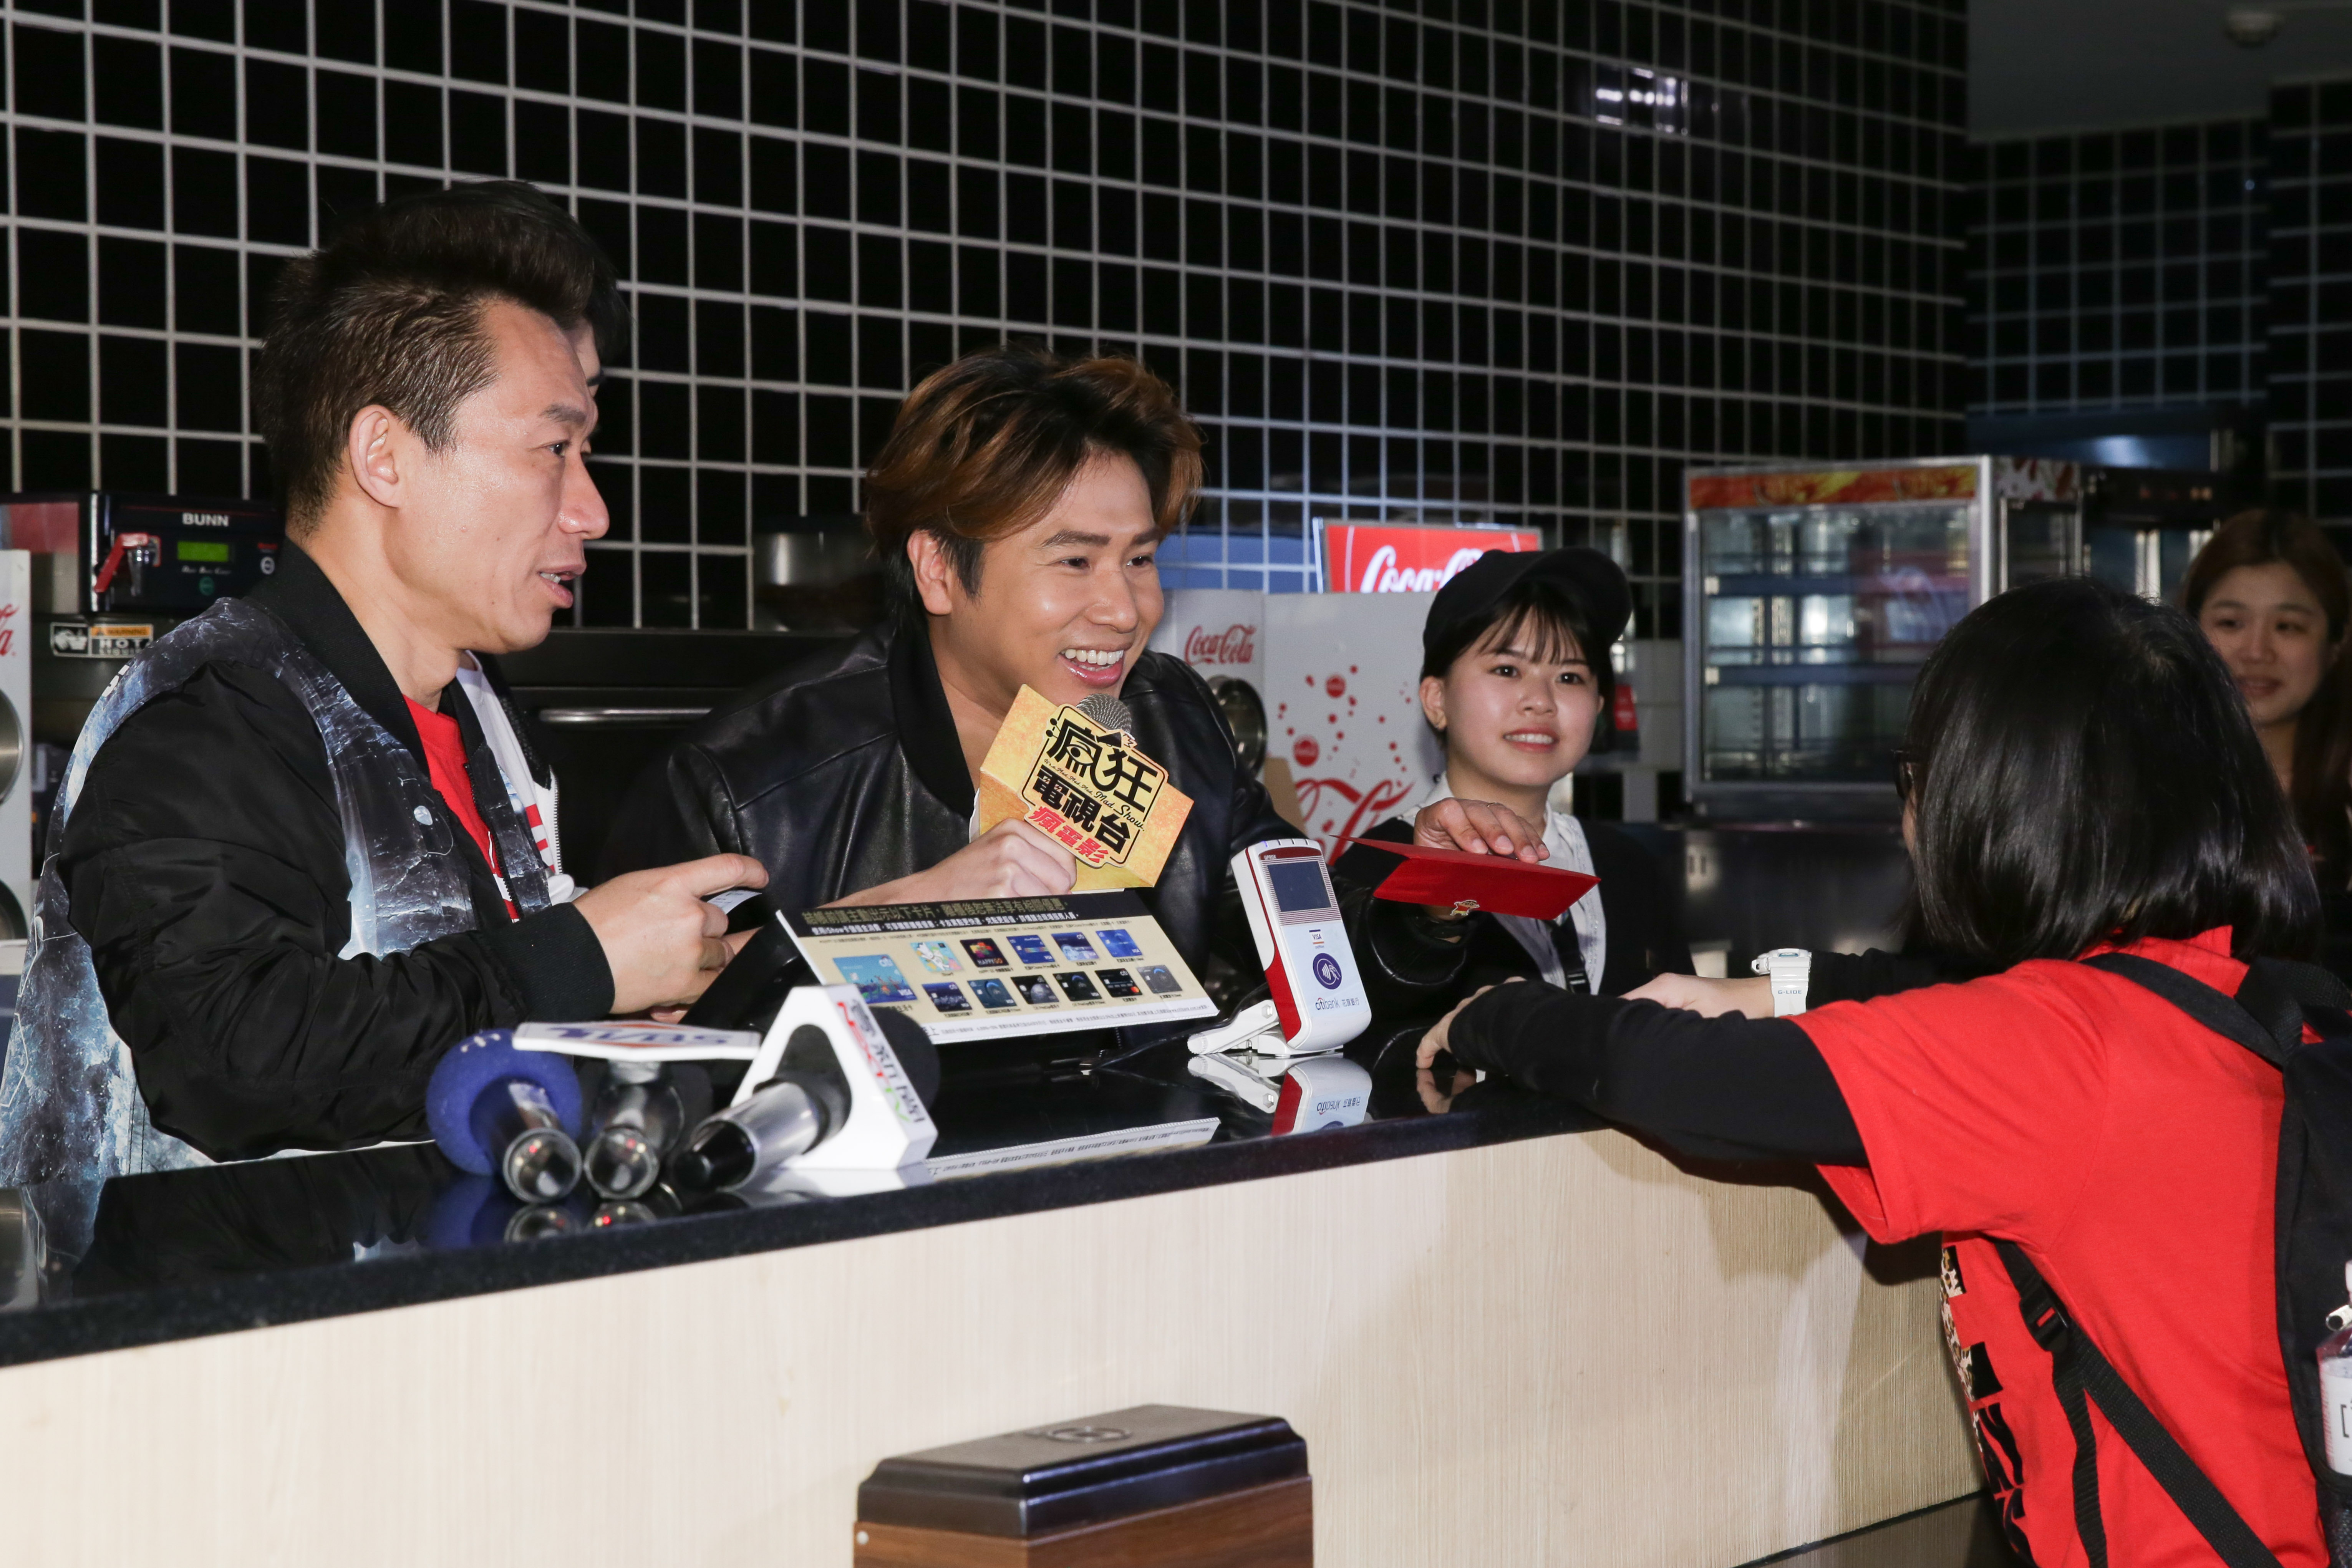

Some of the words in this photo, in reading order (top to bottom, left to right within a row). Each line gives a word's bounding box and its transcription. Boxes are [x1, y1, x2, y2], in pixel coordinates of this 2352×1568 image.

[182, 512, 229, 527] BUNN
[1360, 545, 1483, 593] Coca-C
[99, 639, 143, 649] HOT
[1184, 623, 1257, 666] Coca-Cola
[1033, 764, 1130, 855] 電視台
[1029, 806, 1109, 863] 瘋電影
[1316, 998, 1340, 1010] citibank
